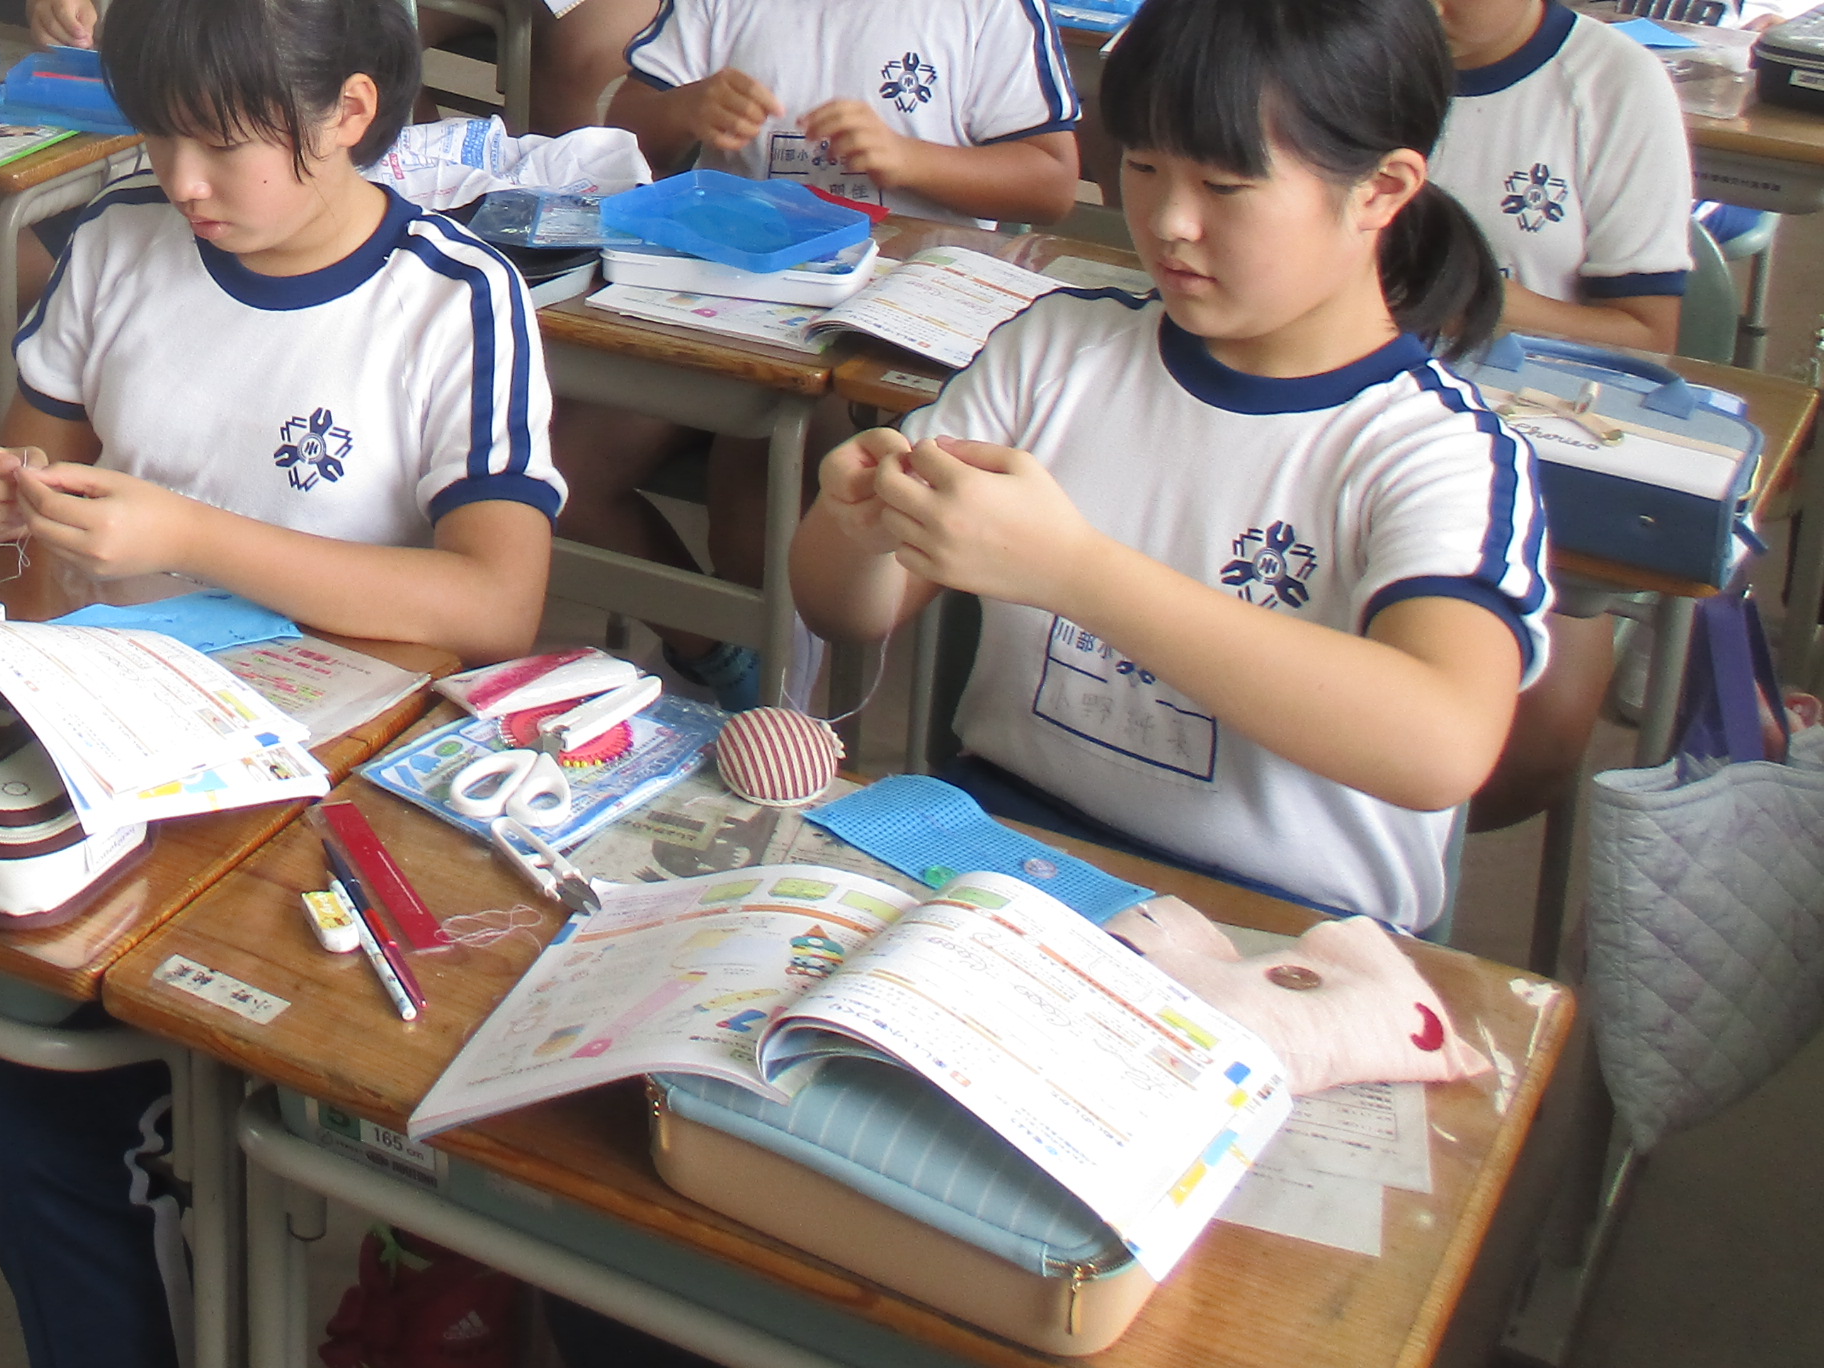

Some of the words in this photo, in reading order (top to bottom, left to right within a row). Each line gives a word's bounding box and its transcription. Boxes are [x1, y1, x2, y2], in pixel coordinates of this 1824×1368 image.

[1053, 621, 1114, 660] 川部小
[374, 1127, 403, 1151] 165
[406, 1146, 425, 1160] cm
